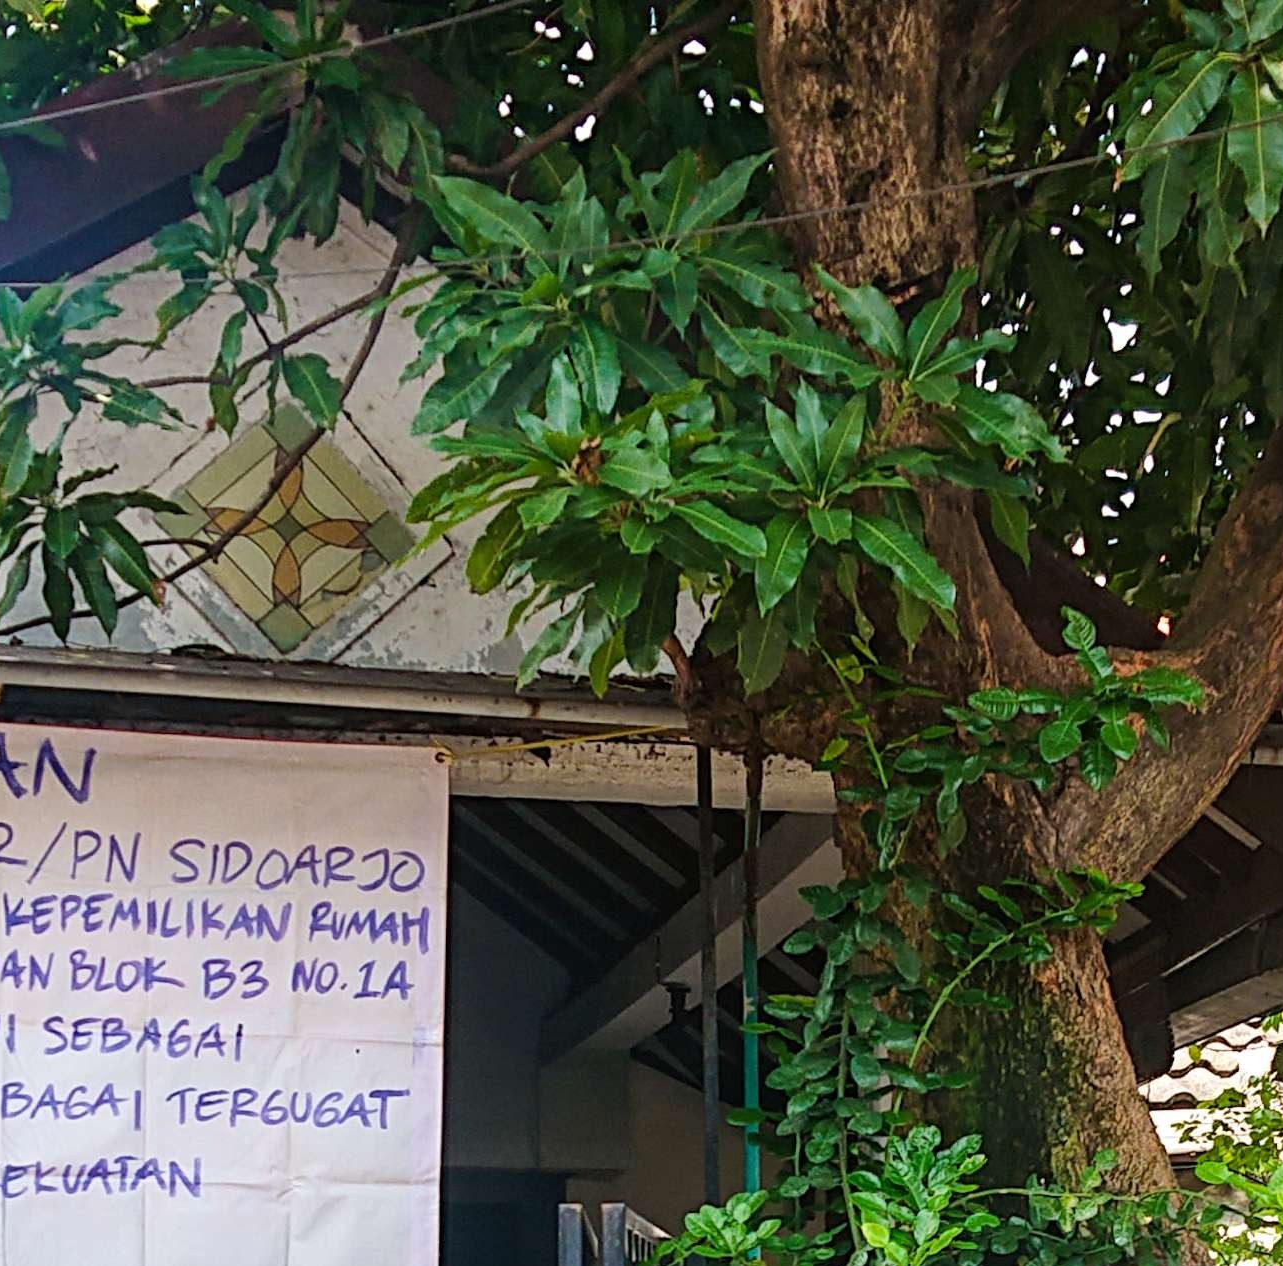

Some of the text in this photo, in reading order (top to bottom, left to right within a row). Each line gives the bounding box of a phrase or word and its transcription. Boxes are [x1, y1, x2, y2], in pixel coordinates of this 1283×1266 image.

[170, 838, 427, 892] SIDOARJO
[2, 891, 293, 944] KEPEMILIKAN
[308, 901, 430, 953] RUMAH
[69, 949, 185, 993] BLOK
[203, 959, 270, 1000] B3
[43, 1016, 246, 1062] SEBAGAI
[165, 1087, 410, 1130] TERGUGAT
